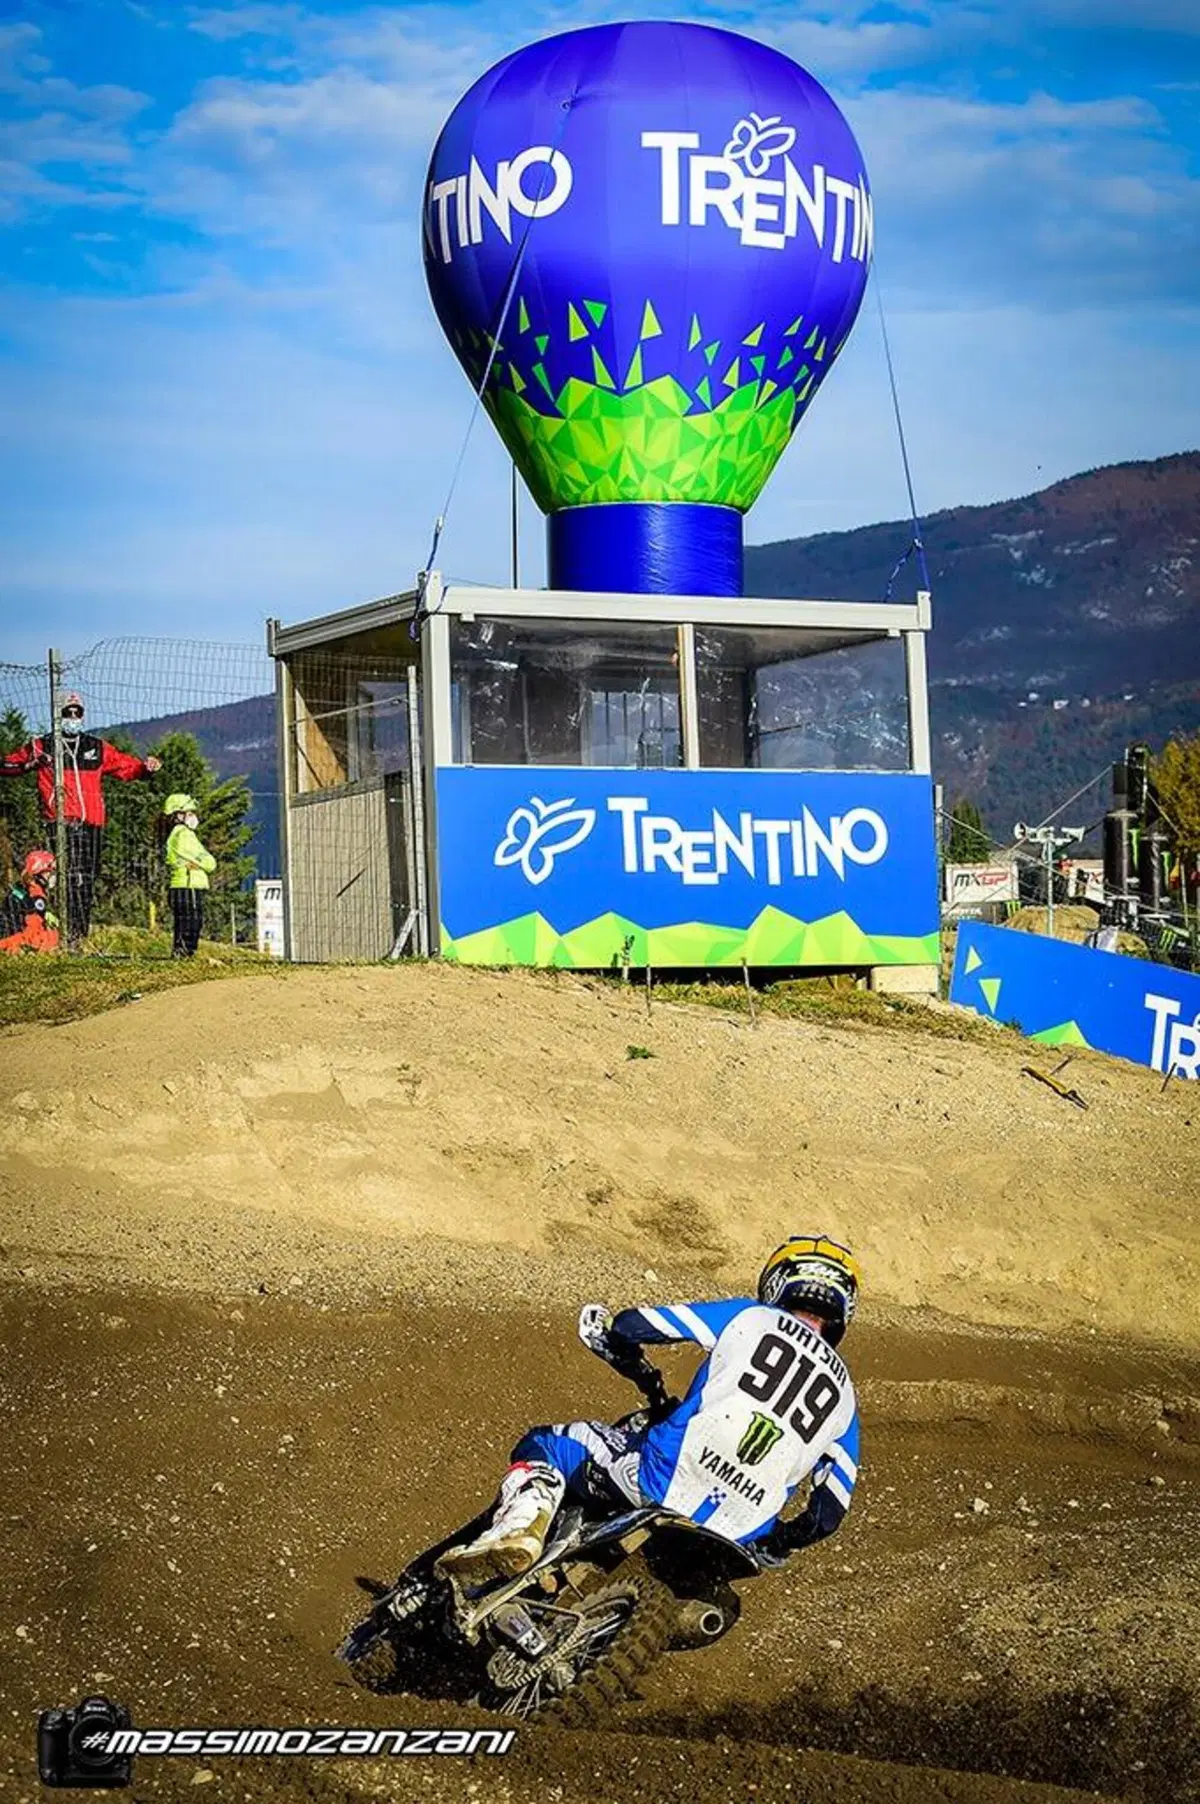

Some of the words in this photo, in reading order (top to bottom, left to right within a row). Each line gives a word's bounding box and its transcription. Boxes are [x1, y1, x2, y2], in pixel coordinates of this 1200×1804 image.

[607, 797, 888, 885] TRENTINO
[738, 1333, 842, 1445] 919
[698, 1446, 768, 1507] YAMAHA
